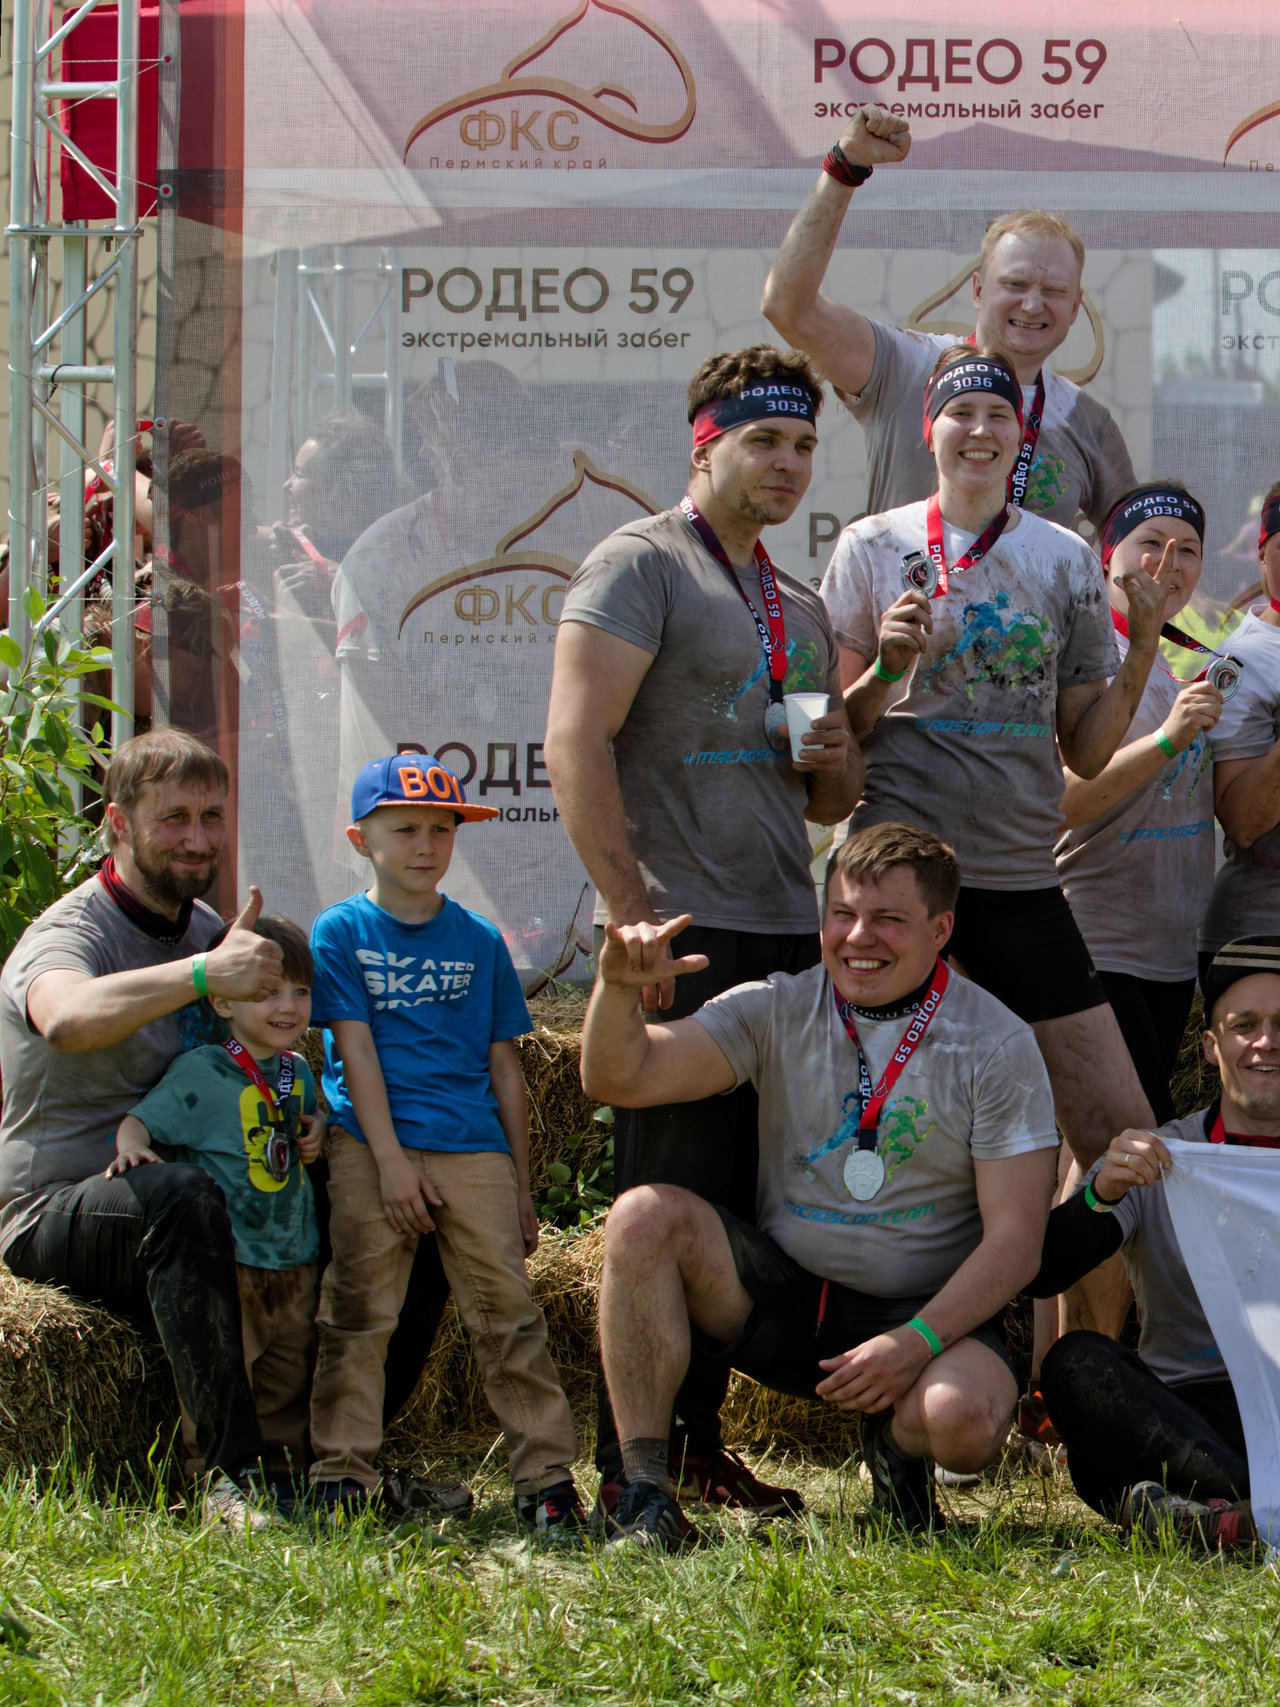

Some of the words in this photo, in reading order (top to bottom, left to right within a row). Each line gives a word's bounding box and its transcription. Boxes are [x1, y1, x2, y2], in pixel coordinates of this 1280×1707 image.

[813, 36, 1022, 92] РОДЕО
[1041, 37, 1108, 85] 59
[813, 98, 1021, 121] эксемальный
[1029, 99, 1105, 121] забег
[459, 109, 581, 153] ФКС
[428, 155, 550, 172] Пермский
[554, 156, 608, 172] край
[400, 266, 610, 322] РОДЕО
[627, 267, 695, 314] 59
[400, 328, 610, 352] экстремальный
[616, 328, 692, 350] забег
[937, 363, 989, 390] РОДЕО
[993, 367, 1011, 383] 59
[952, 375, 994, 392] 3036
[740, 384, 802, 401] РОДЕО
[766, 400, 809, 415] 3032
[1020, 442, 1033, 460] 59
[1013, 461, 1029, 506] РОДЕО
[1124, 495, 1179, 519] РОДЕО
[1144, 506, 1183, 520] 3039
[760, 557, 777, 601] РОДЕО
[453, 583, 568, 627] ФКС
[767, 603, 780, 618] 59
[424, 630, 538, 647] Пермский
[397, 761, 463, 805] BOY
[363, 970, 472, 996] SKATER
[905, 989, 941, 1044] РОДЕО
[226, 1039, 243, 1056] 59
[894, 1044, 912, 1064] 59
[281, 1055, 293, 1069] 59
